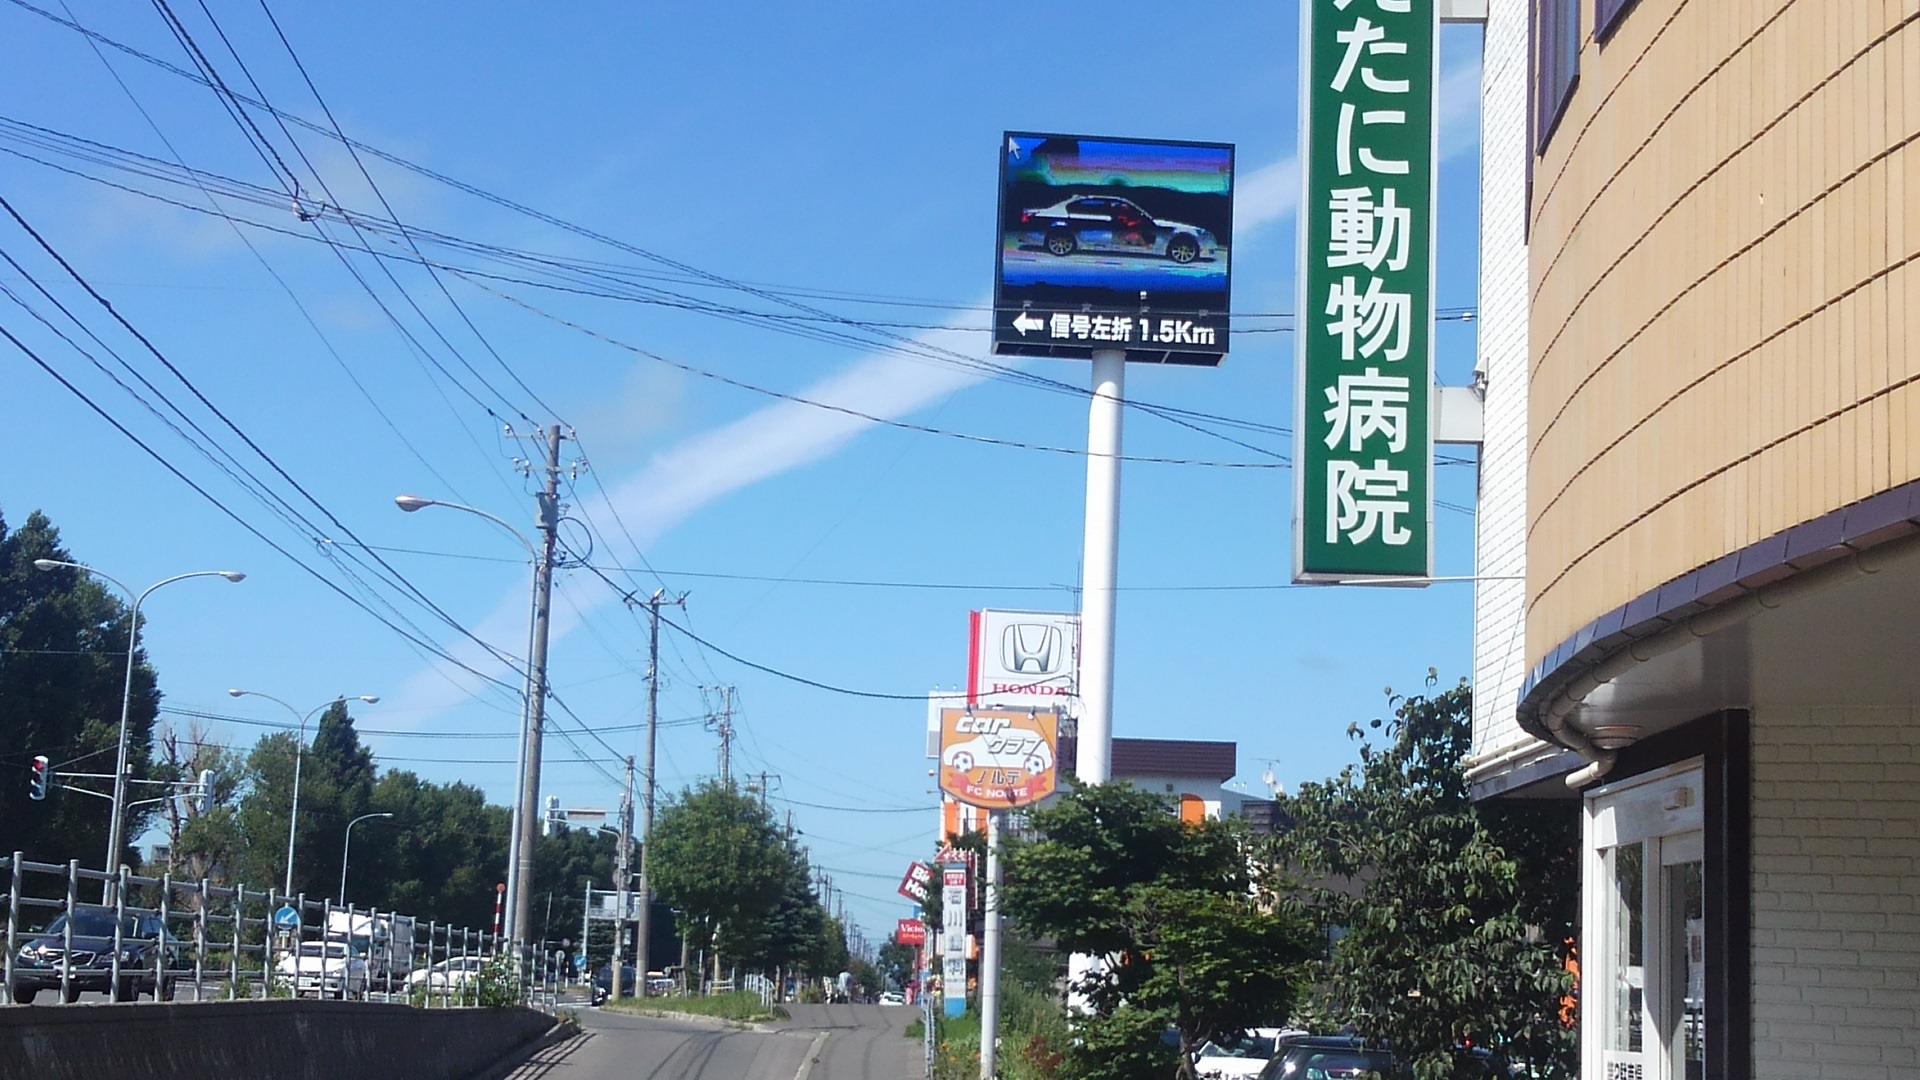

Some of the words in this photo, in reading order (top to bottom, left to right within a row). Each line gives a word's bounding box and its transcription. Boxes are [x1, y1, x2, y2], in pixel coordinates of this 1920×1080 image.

[1050, 313, 1132, 342] 信号左折
[1140, 318, 1215, 345] 1.5Km
[992, 683, 1067, 696] HONDA
[955, 717, 1011, 735] car
[976, 769, 1020, 786] ノルテ
[966, 785, 982, 795] FC
[900, 923, 926, 933] Victo
